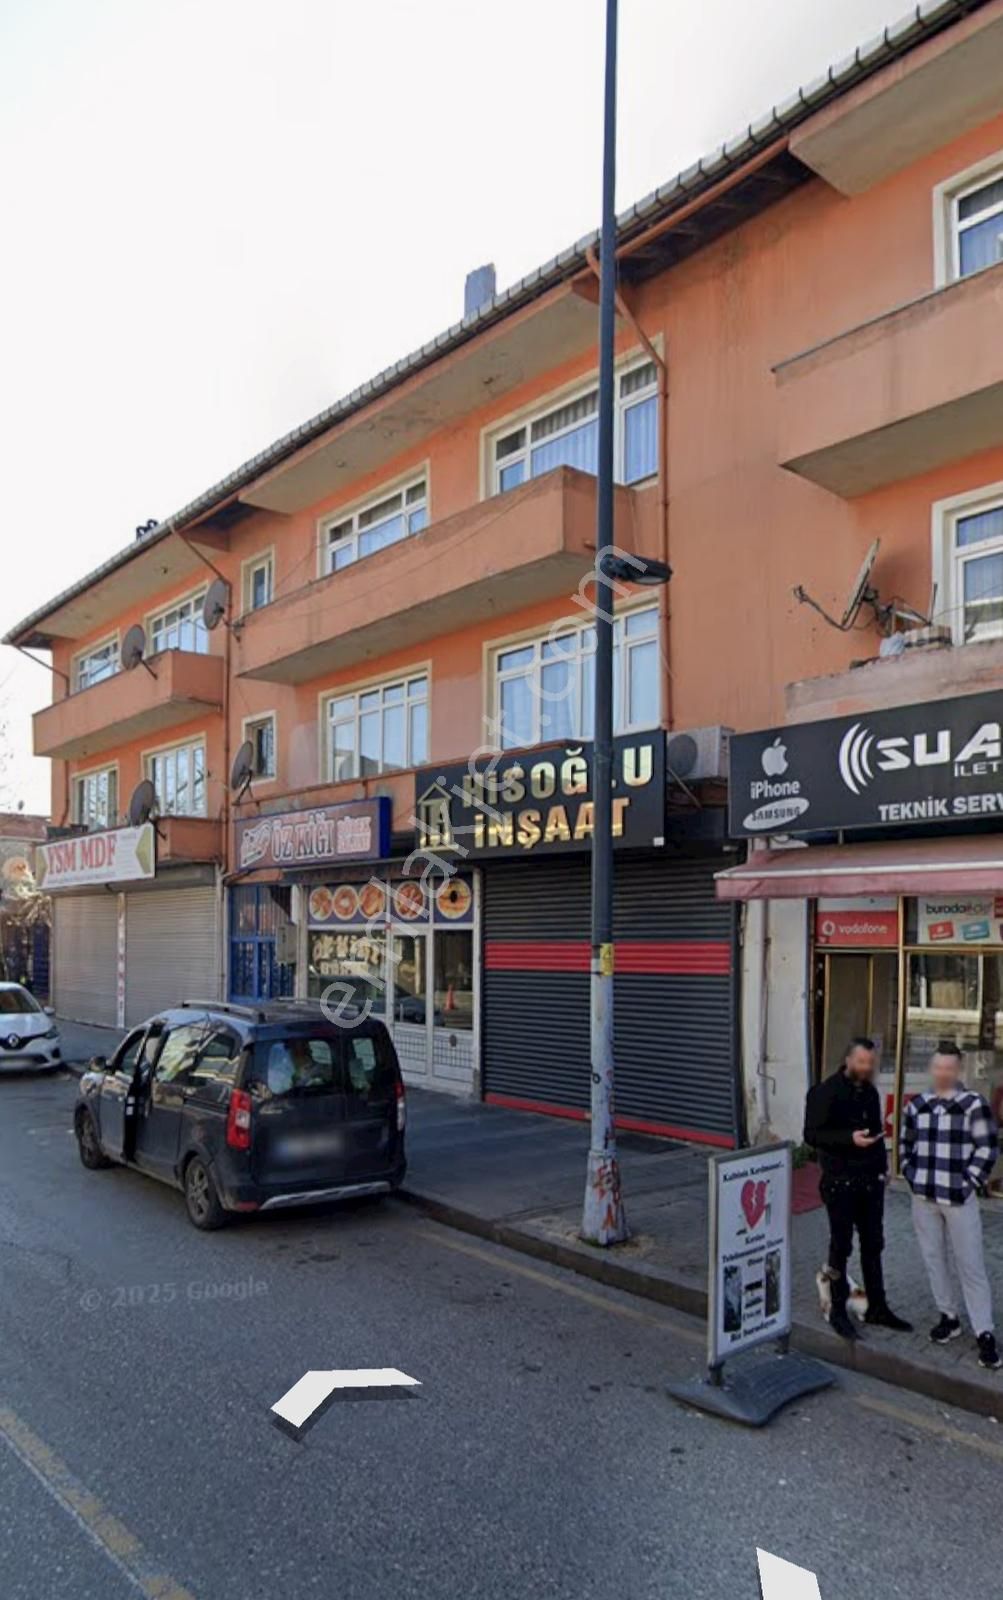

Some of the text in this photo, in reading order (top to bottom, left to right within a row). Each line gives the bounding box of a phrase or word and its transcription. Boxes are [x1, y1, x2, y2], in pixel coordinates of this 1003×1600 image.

[463, 745, 652, 808] HİSOĞU
[750, 780, 800, 799] iPhone
[752, 806, 800, 821] SAMSUNG
[878, 796, 948, 822] TEKNİK
[474, 797, 630, 848] İNŞAAT
[79, 833, 117, 870] MDF
[838, 920, 888, 935] vodafone
